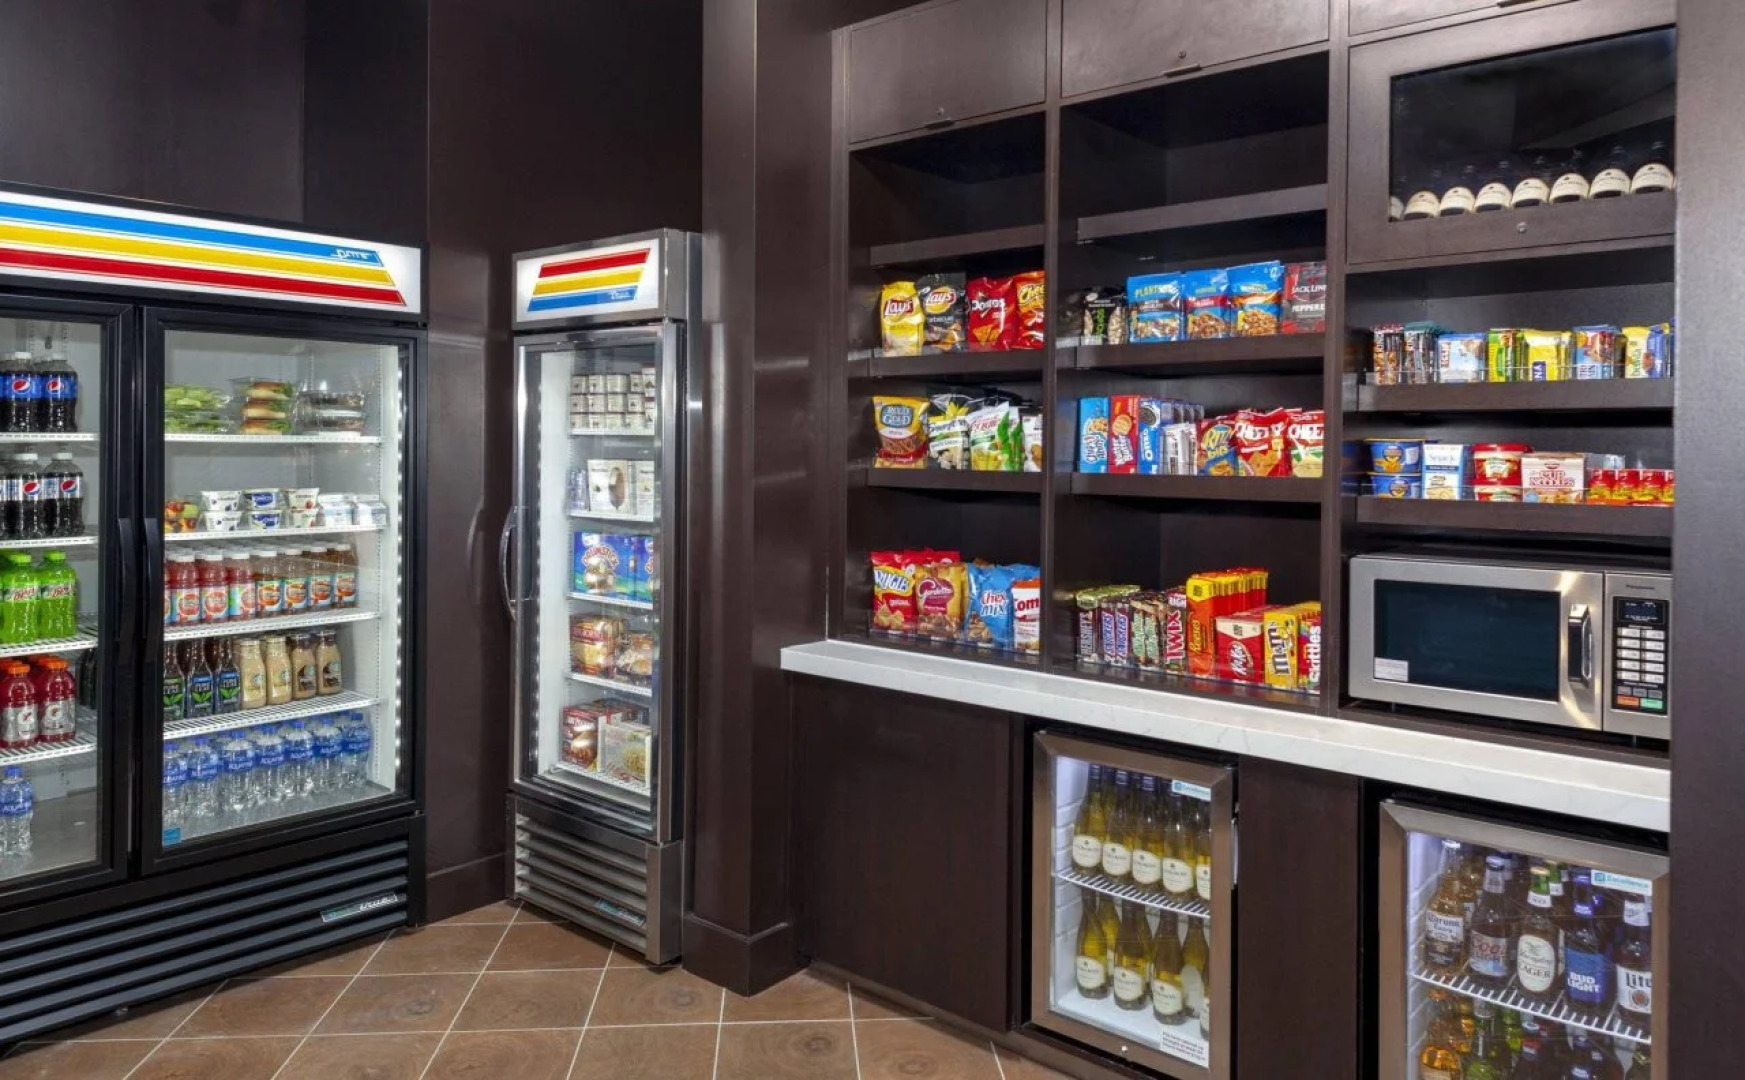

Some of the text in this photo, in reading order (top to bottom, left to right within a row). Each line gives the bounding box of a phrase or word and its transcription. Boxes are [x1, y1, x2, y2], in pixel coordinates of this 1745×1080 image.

[926, 290, 955, 306] Lay's
[885, 300, 913, 316] Lay's
[882, 415, 911, 425] GOLD
[1142, 428, 1154, 462] OREO
[1163, 609, 1185, 664] TWIX
[1428, 914, 1460, 927] Corona
[1473, 933, 1506, 954] Coo
[1567, 977, 1600, 993] LIGHT
[1569, 971, 1596, 984] BUD
